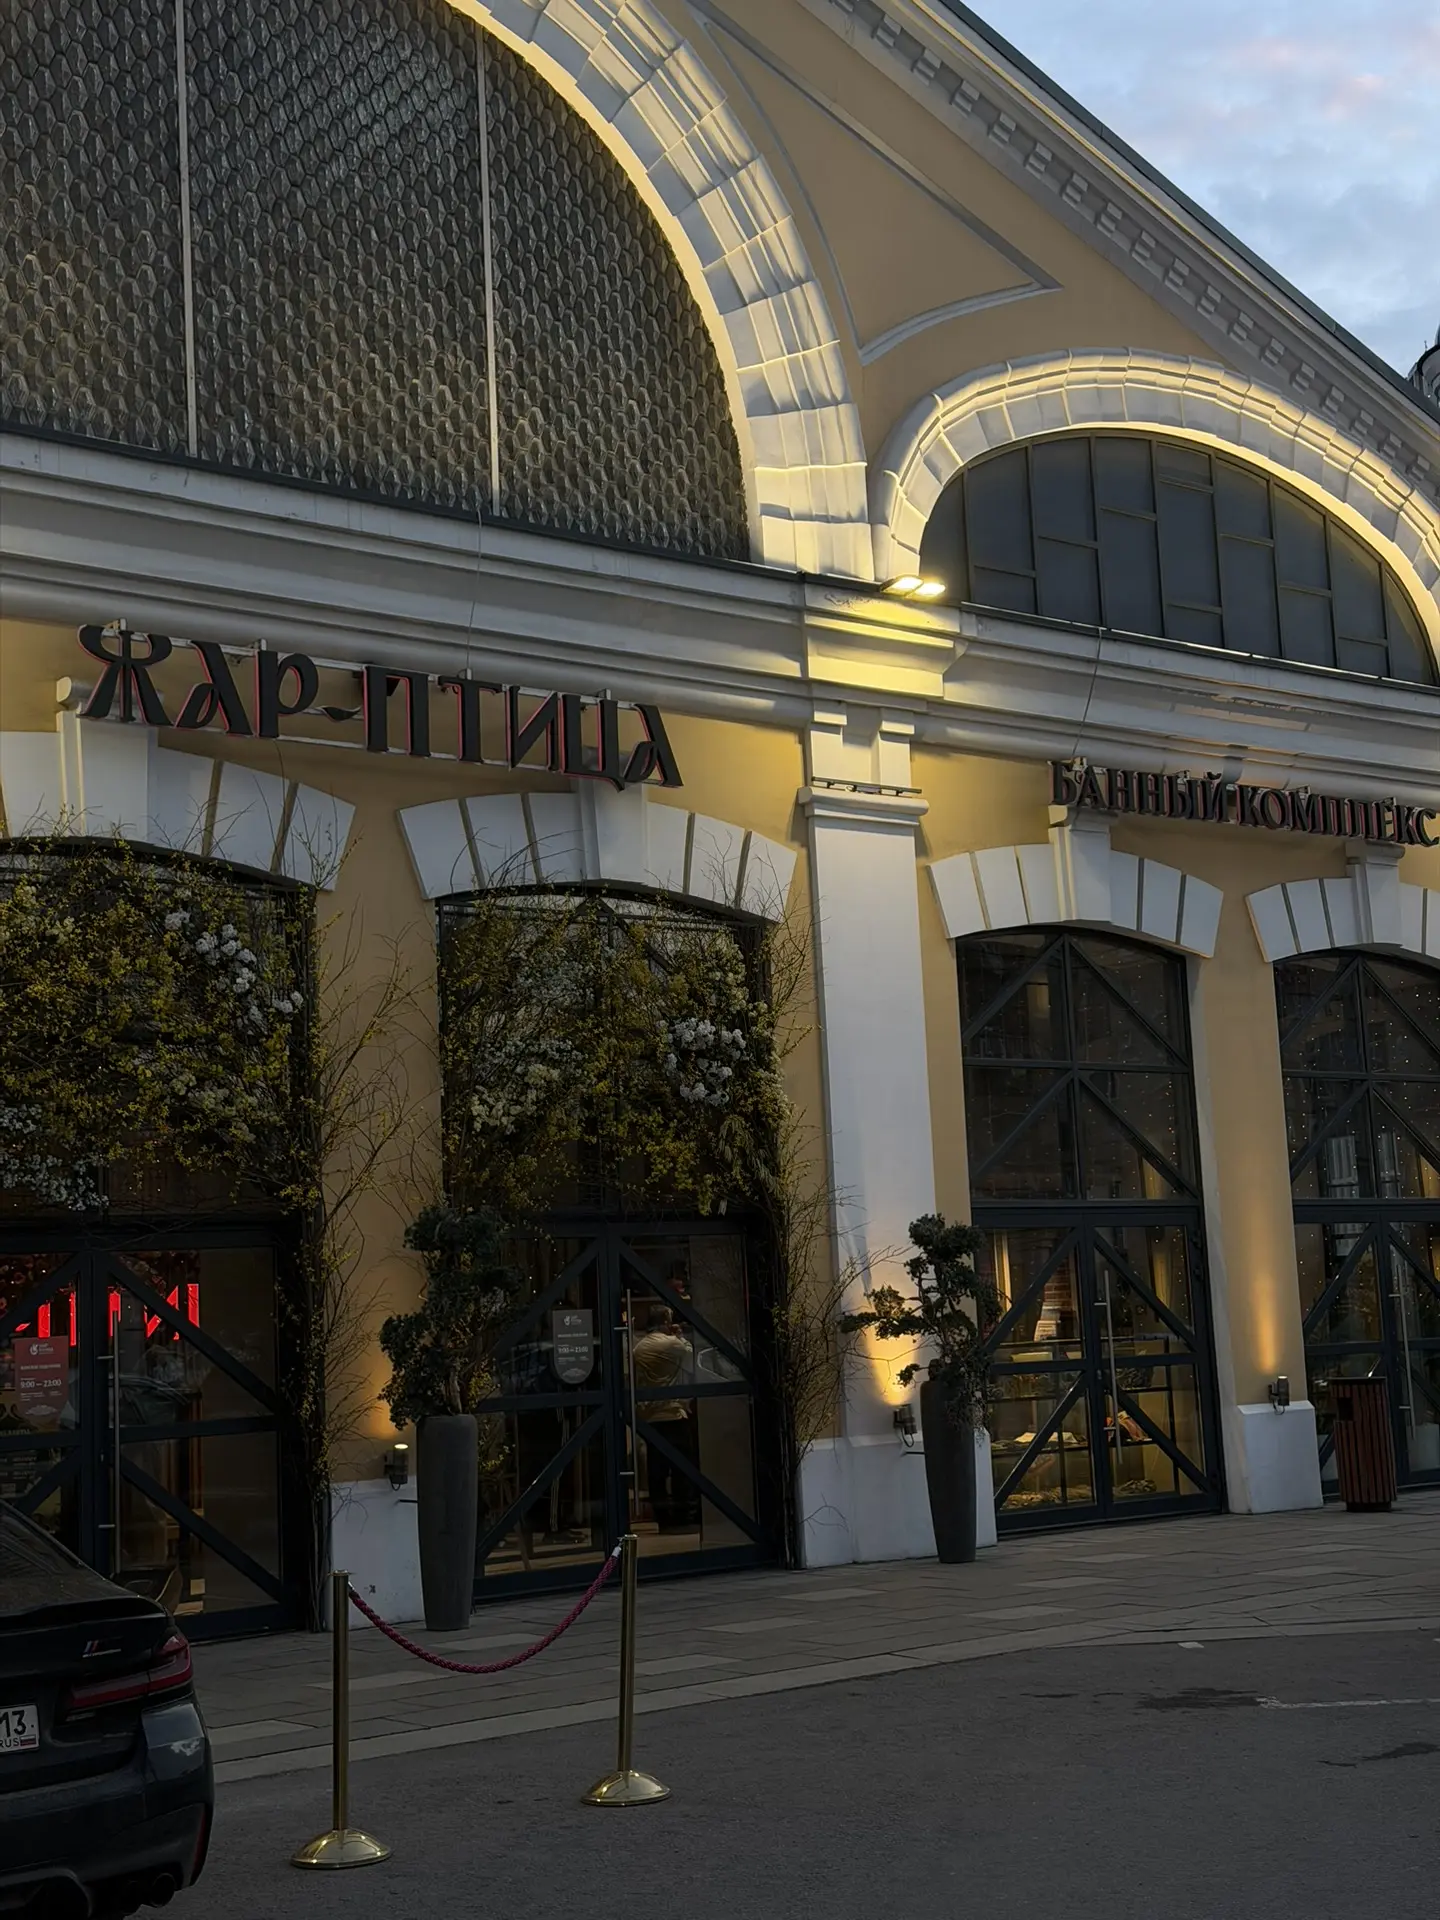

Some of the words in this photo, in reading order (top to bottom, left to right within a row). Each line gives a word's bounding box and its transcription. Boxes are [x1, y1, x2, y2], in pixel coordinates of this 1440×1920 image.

[76, 623, 684, 792] ЖАР-ПТИЦА
[1049, 760, 1229, 823] БАННЫЙ
[1235, 783, 1440, 847] КОМПЛЕКС
